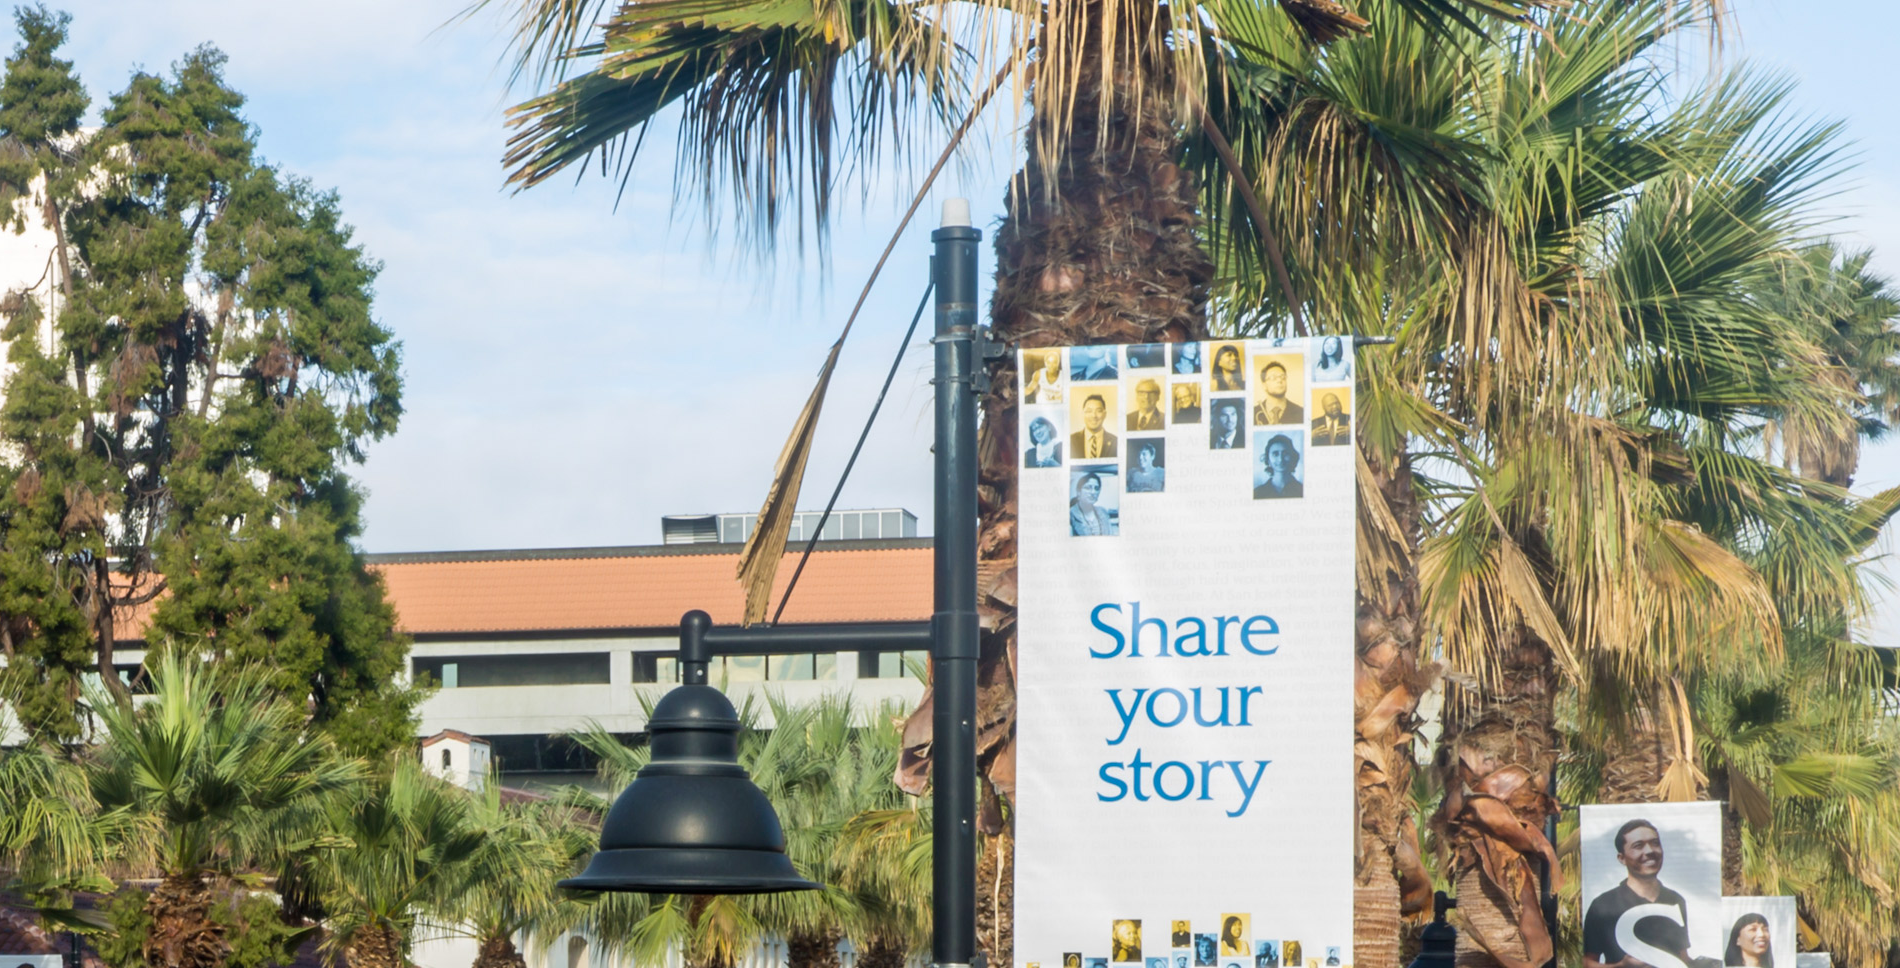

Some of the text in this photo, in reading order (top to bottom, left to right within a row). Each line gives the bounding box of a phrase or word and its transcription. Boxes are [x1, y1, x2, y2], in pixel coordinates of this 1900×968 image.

[1089, 601, 1280, 659] Share
[1103, 686, 1264, 746] your
[1096, 748, 1273, 818] story
